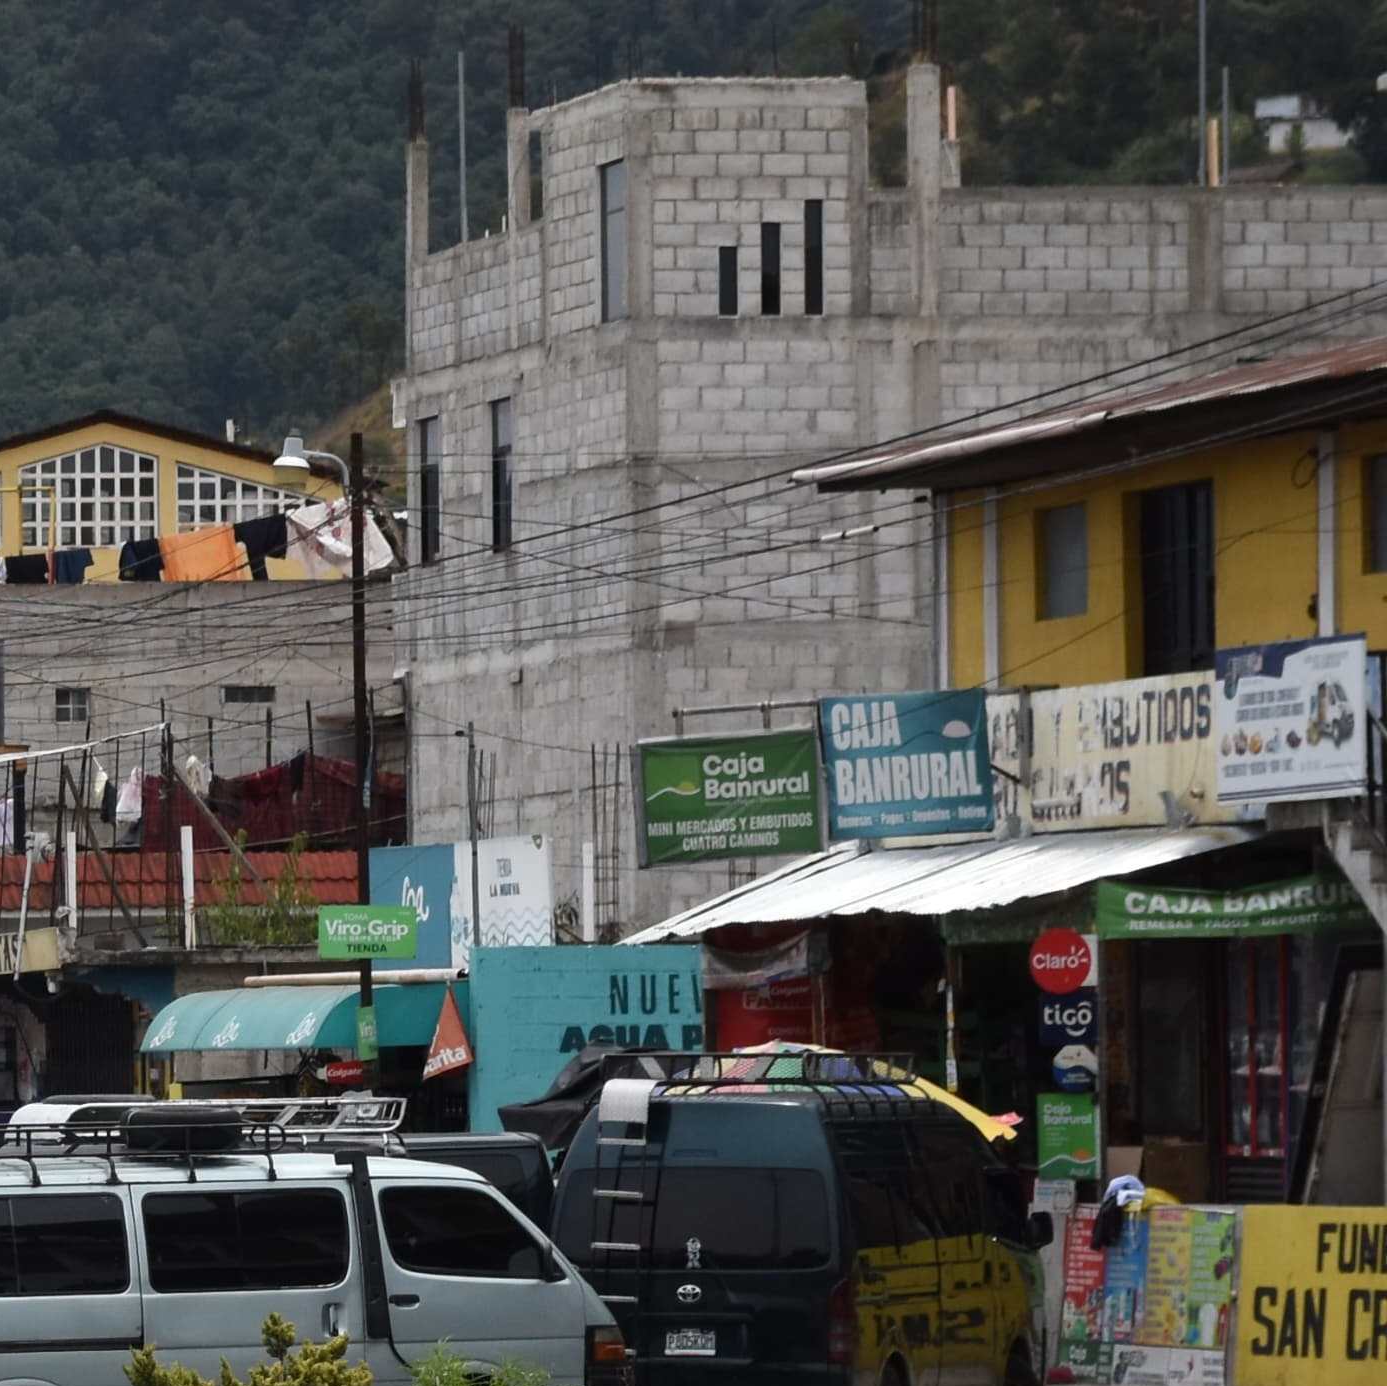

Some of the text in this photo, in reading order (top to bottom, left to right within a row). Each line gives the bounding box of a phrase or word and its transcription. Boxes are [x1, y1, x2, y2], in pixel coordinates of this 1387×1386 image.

[830, 700, 902, 752] CAJA
[702, 752, 765, 780] Caja
[834, 749, 983, 806] BANRURAL
[704, 771, 811, 800] Banrural
[648, 812, 813, 837] MINI MERCADOS Y EMBUTIDOS
[682, 831, 780, 851] CUATRO CAMINOS
[1124, 891, 1213, 915] CAJA
[347, 943, 388, 953] TIENDA
[1031, 953, 1079, 970] Claro
[1251, 1286, 1328, 1359] SAN
